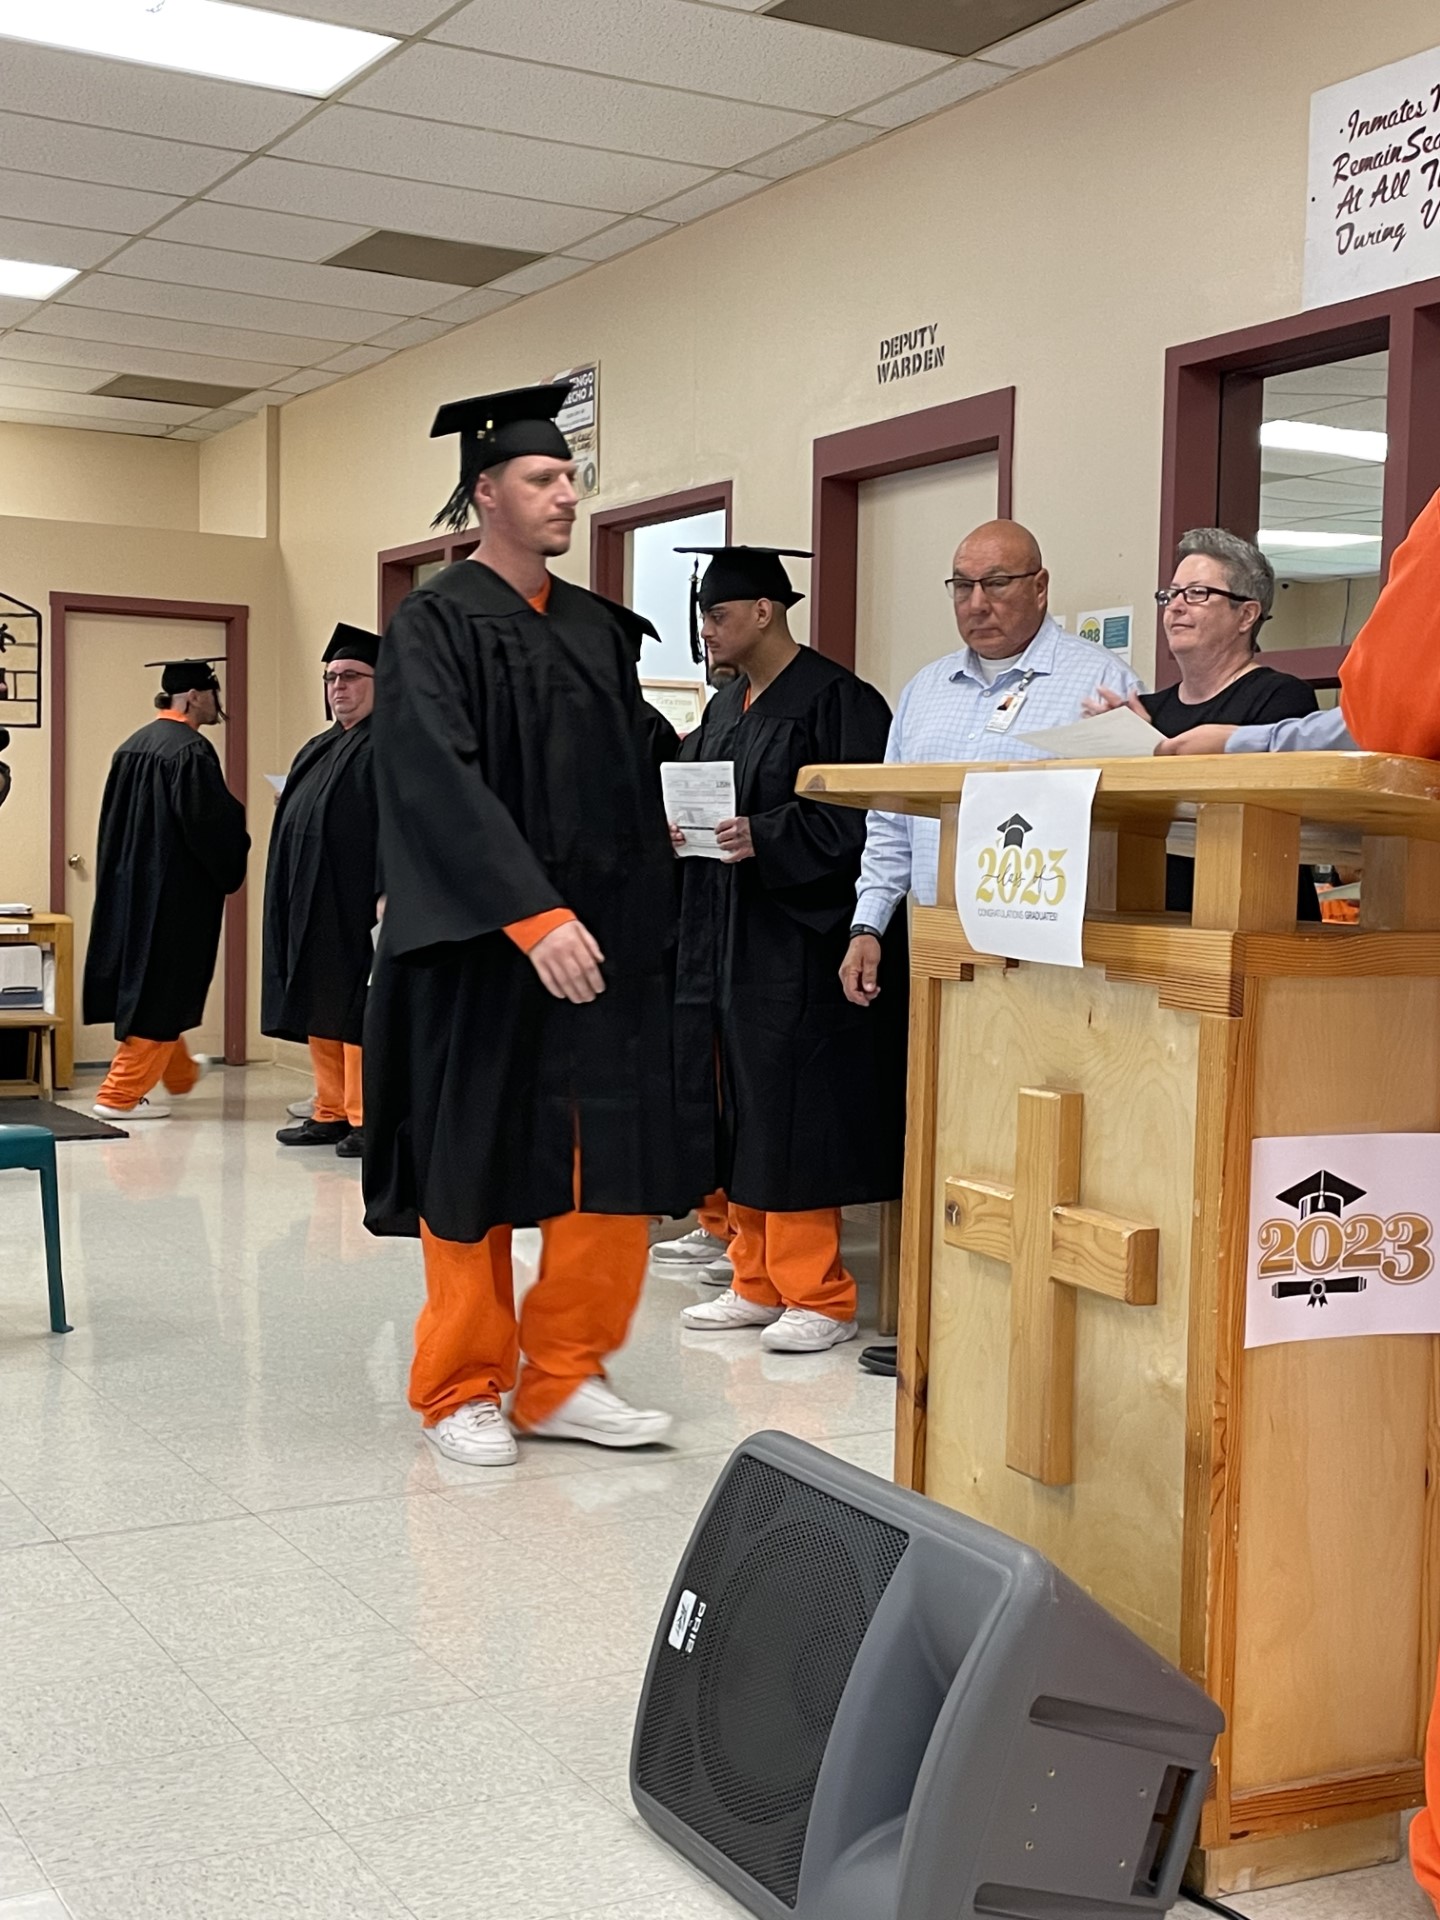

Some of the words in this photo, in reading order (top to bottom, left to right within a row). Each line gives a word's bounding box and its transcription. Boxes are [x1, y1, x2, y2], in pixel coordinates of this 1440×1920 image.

[1348, 99, 1427, 143] Inmates
[1332, 143, 1403, 188] Remain
[1335, 184, 1365, 219] At
[1369, 167, 1411, 208] All
[1335, 222, 1408, 256] During
[879, 322, 938, 361] DEPUTY
[877, 344, 945, 385] WARDEN
[975, 847, 1069, 906] 2023
[1257, 1211, 1435, 1286] 2023
